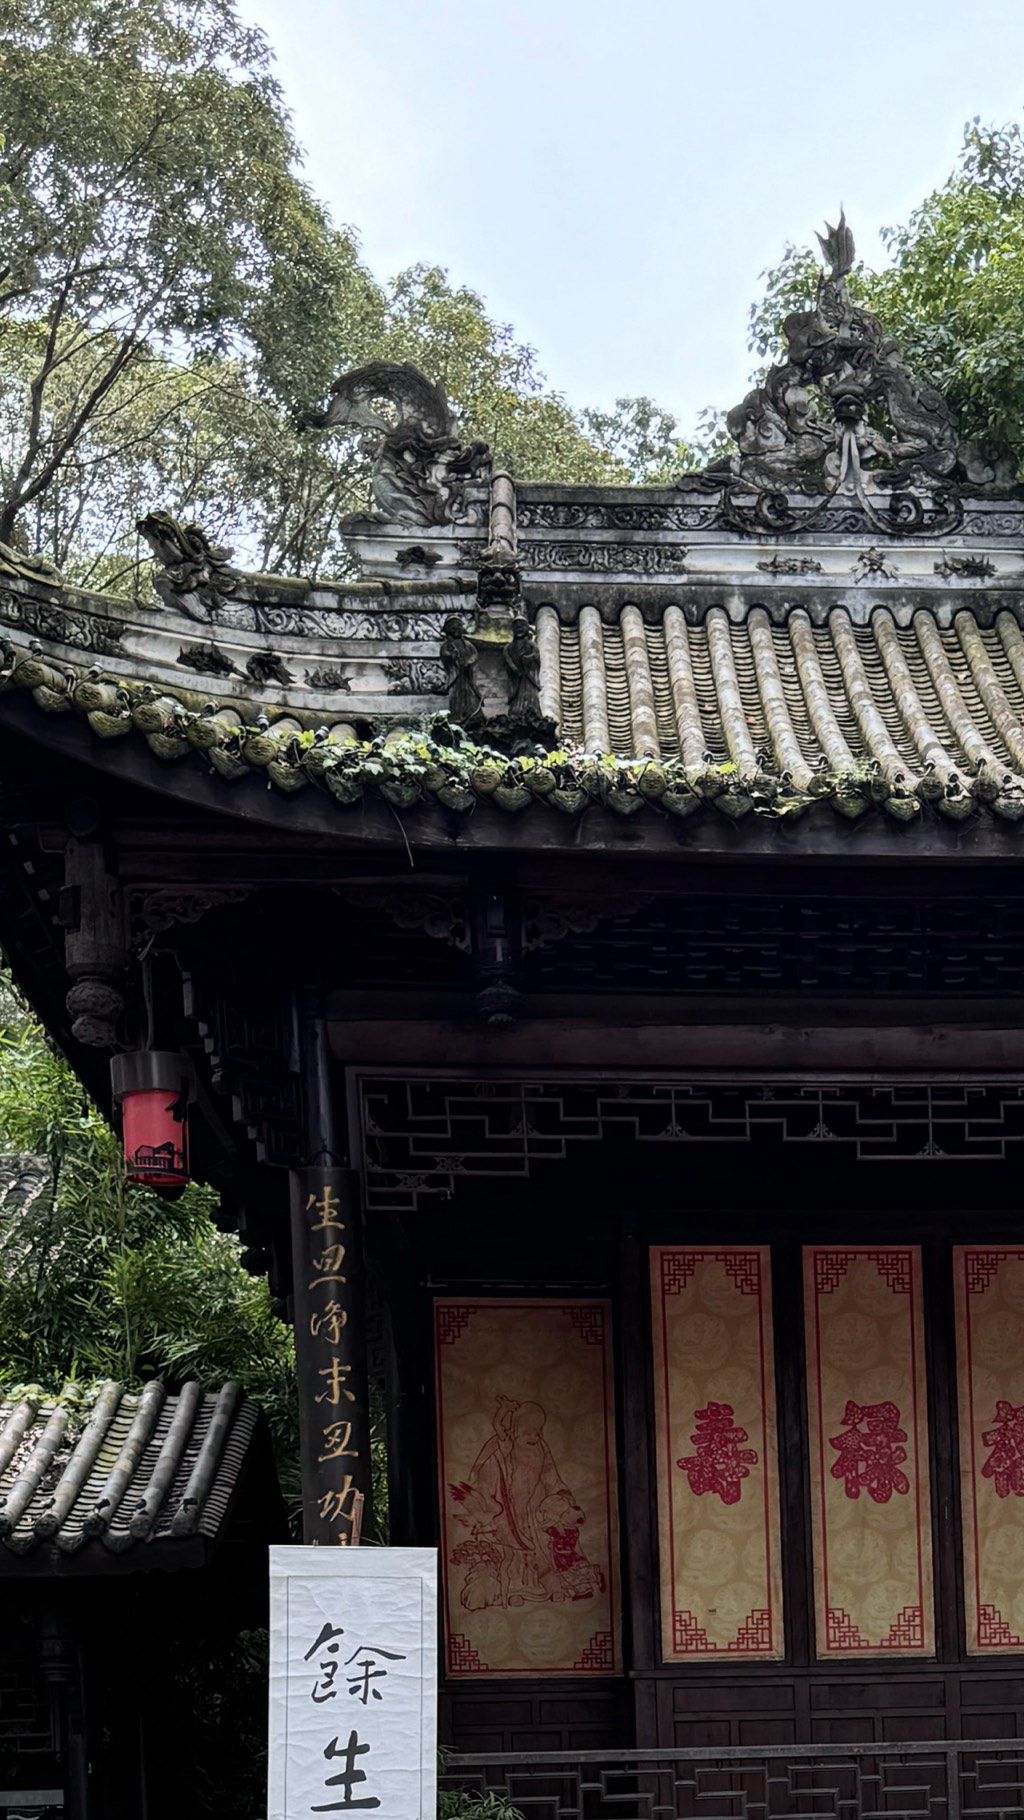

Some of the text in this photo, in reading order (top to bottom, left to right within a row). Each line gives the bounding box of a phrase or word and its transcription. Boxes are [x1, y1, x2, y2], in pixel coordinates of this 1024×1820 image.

[305, 1185, 360, 1546] 生旦净末丑功
